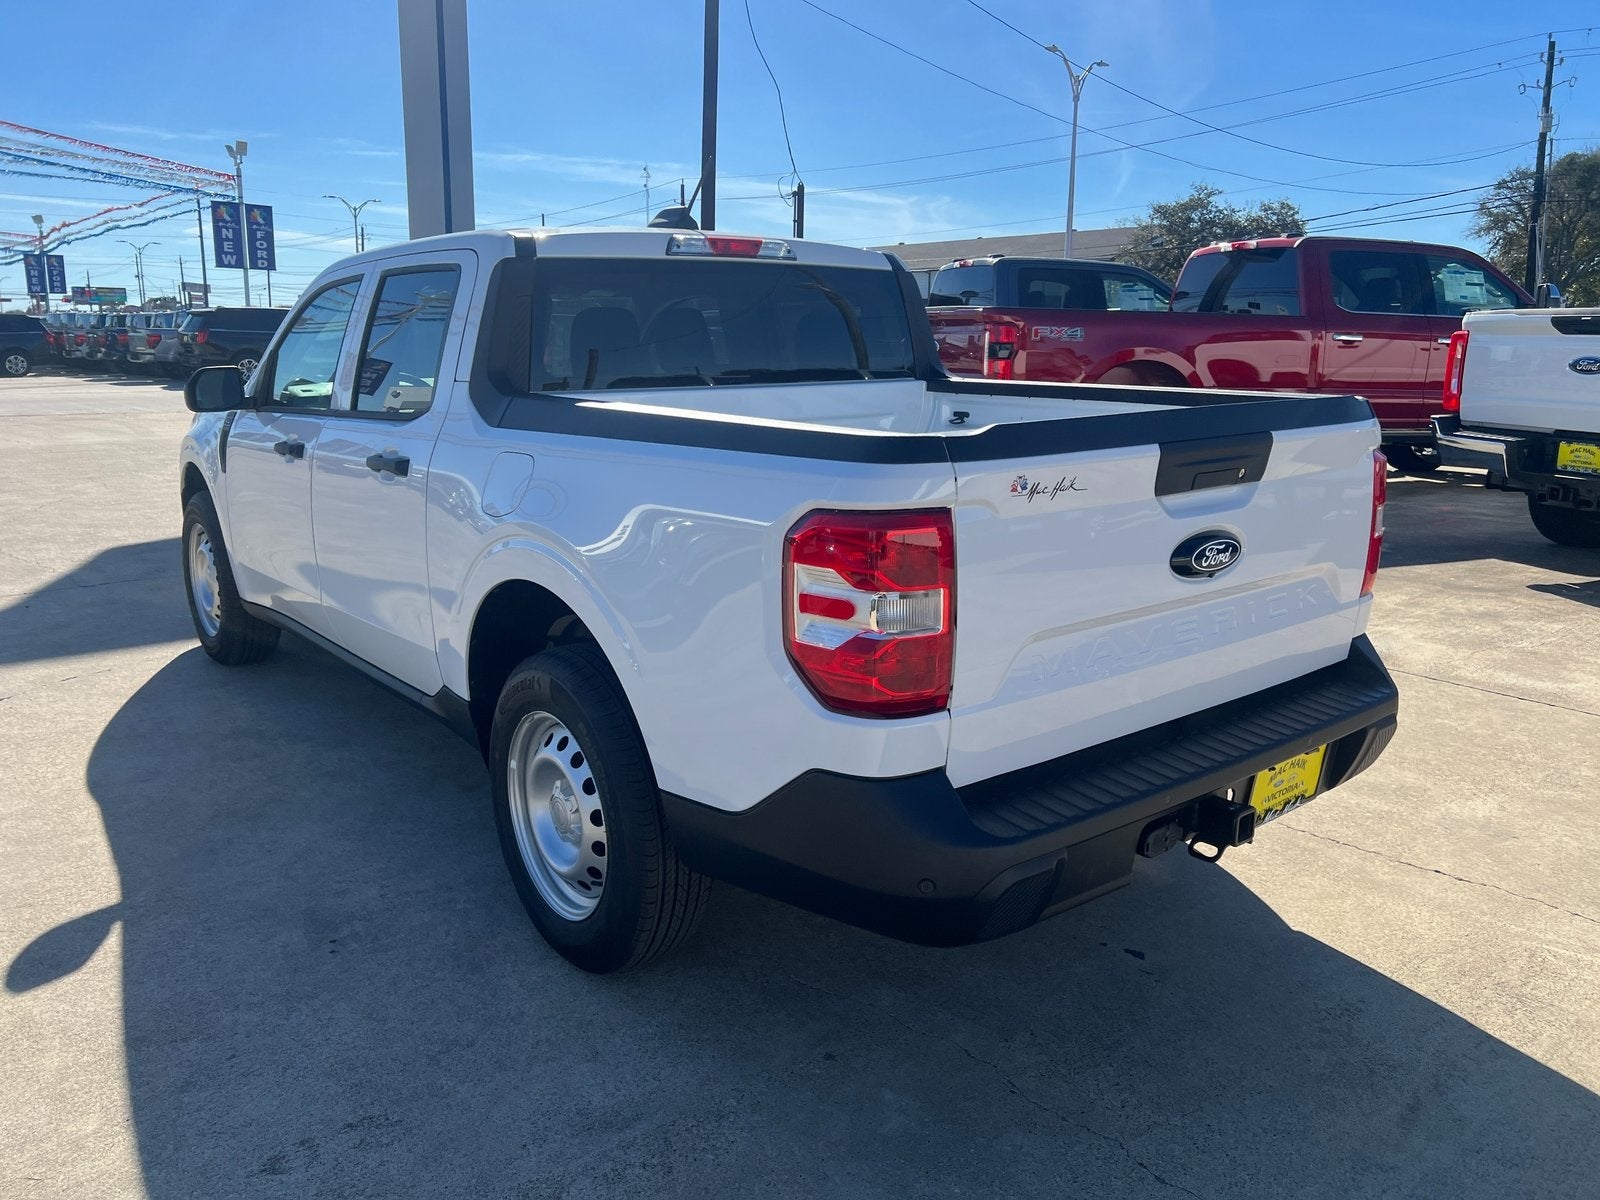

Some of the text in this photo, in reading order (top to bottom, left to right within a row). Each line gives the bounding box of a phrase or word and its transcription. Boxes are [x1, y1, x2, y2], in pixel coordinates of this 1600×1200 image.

[221, 228, 237, 265] NEW
[255, 231, 268, 268] FORD
[30, 269, 41, 292] NEW
[1032, 326, 1085, 341] FX4
[1576, 359, 1600, 371] Ford
[1026, 476, 1088, 503] Mac Haik
[1201, 543, 1233, 567] Ford
[1032, 583, 1319, 681] MAVERICK
[1267, 761, 1289, 786] MAC
[1289, 757, 1308, 771] HAIK
